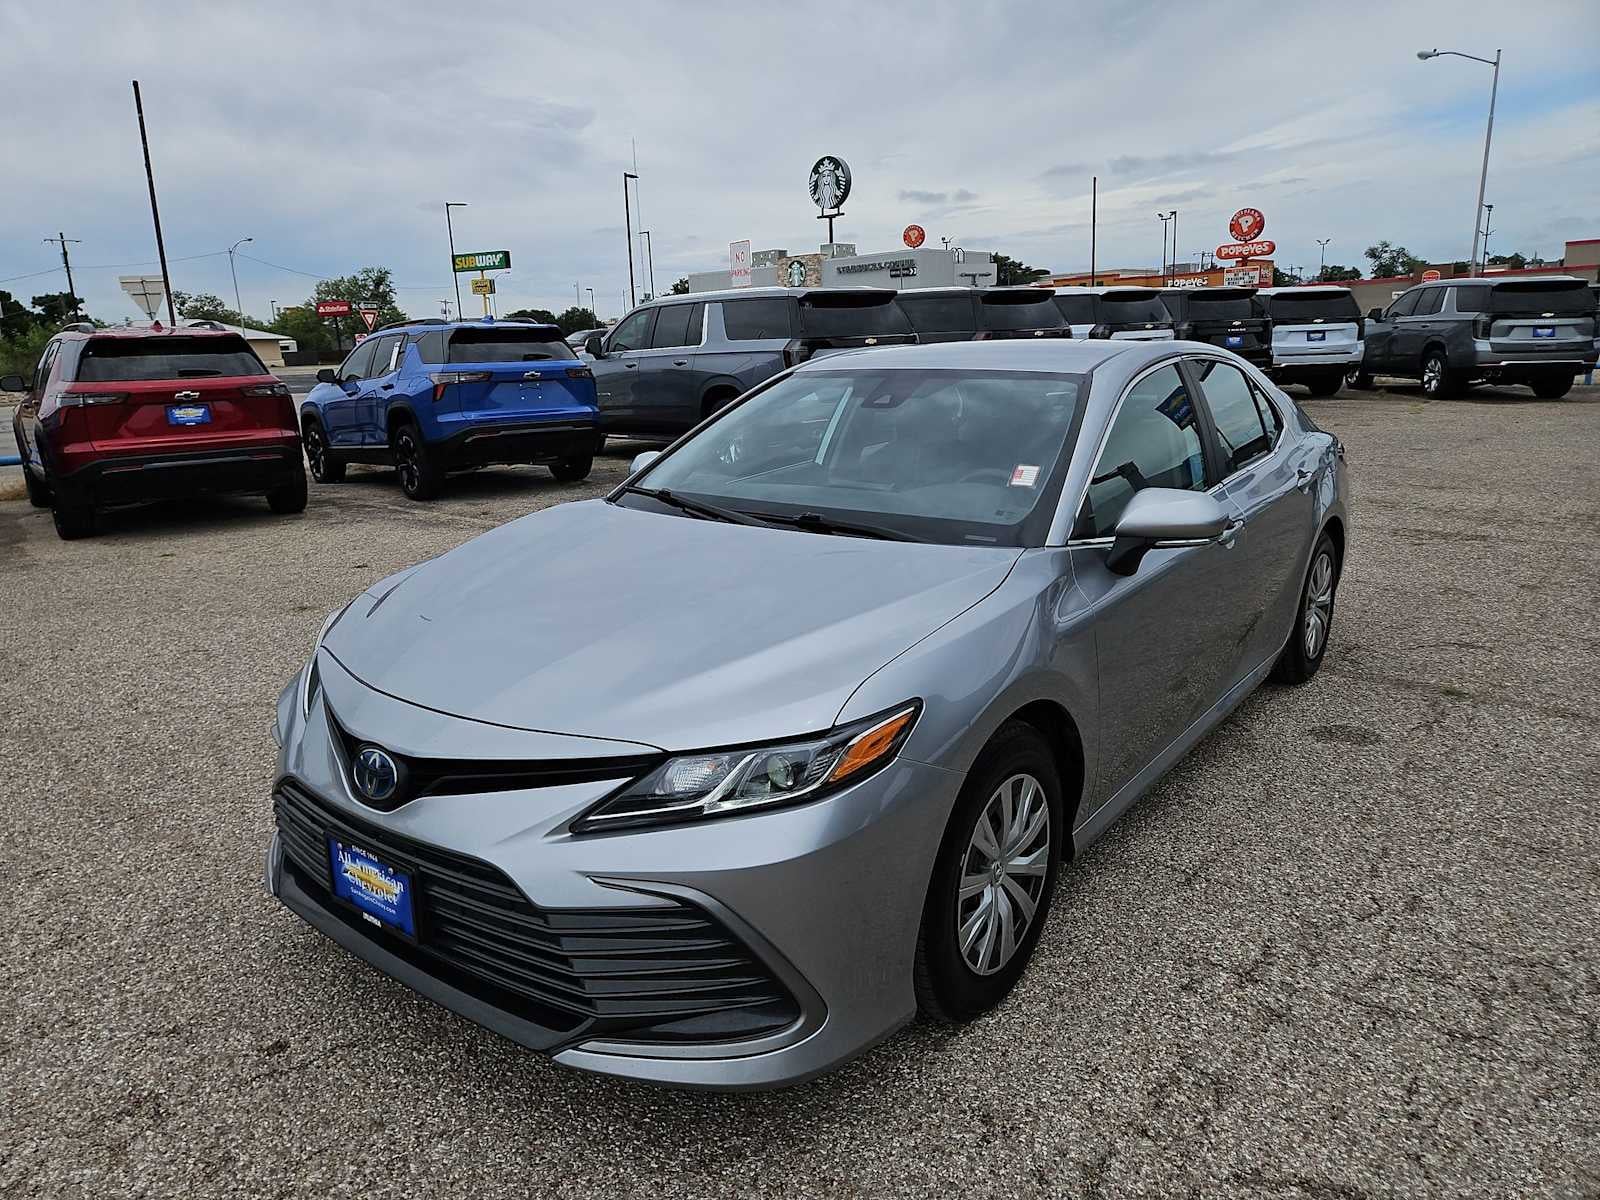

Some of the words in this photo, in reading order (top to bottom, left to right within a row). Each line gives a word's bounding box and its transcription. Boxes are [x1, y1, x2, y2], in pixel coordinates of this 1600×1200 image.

[455, 253, 503, 269] SUBWAY
[735, 251, 745, 263] NO
[347, 870, 399, 906] Chevrolet
[354, 858, 404, 893] American
